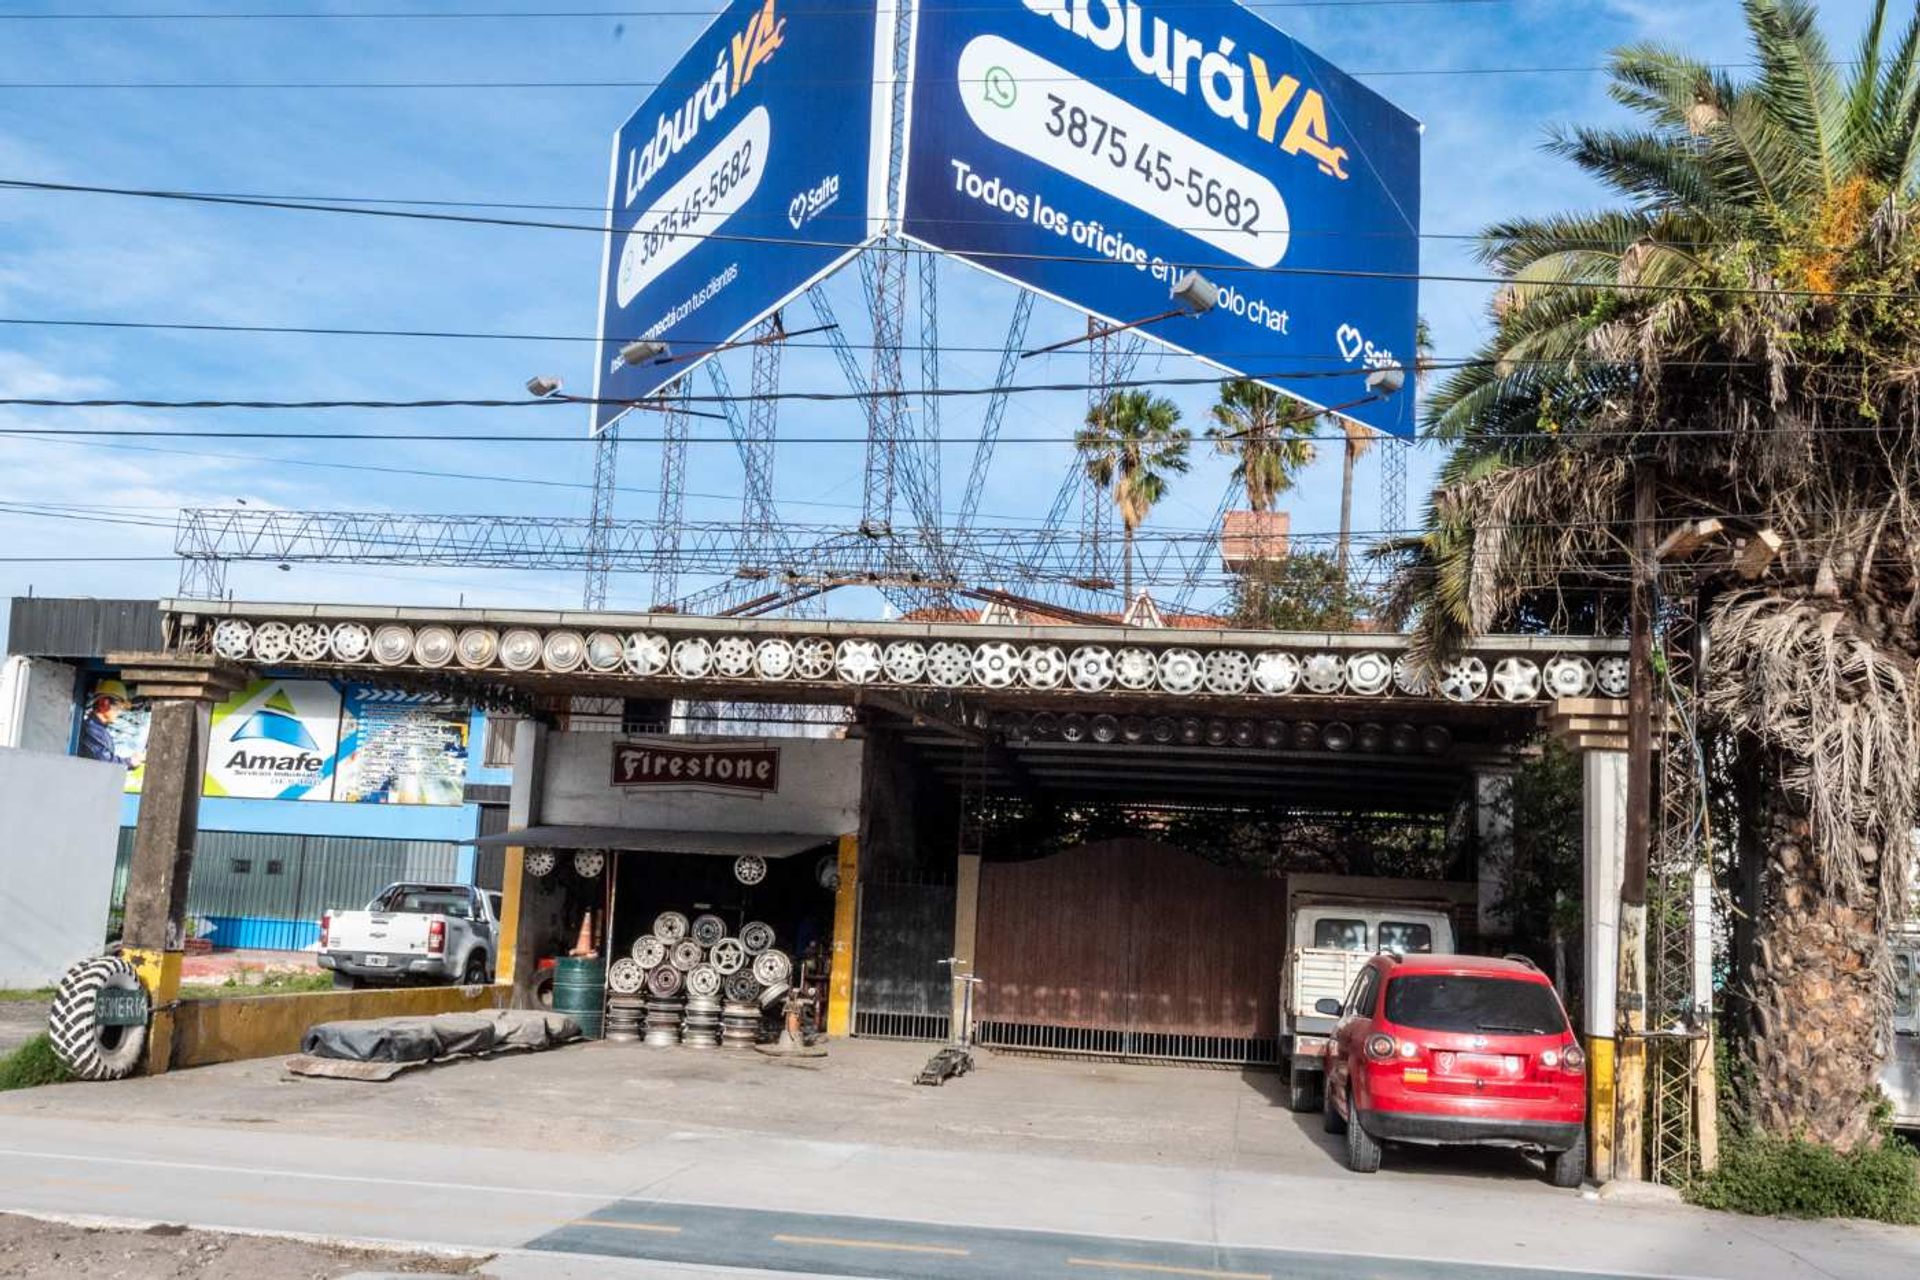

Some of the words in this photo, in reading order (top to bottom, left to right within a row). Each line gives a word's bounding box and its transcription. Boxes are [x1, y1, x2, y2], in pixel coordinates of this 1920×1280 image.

[807, 174, 839, 211] Salta
[1044, 92, 1127, 168] 3875
[1134, 142, 1260, 237] 45-5682
[640, 206, 678, 266] 3875
[681, 139, 752, 229] 45-5682
[951, 159, 1029, 219] Todos
[1033, 194, 1069, 236] los
[1071, 219, 1147, 271] oficios
[1151, 256, 1177, 287] en
[1210, 282, 1246, 316] olo
[1247, 298, 1289, 335] chat
[676, 298, 693, 321] con
[692, 291, 706, 311] tus
[706, 262, 738, 300] clientes
[225, 750, 323, 772] Amafe
[620, 750, 770, 780] Firestone
